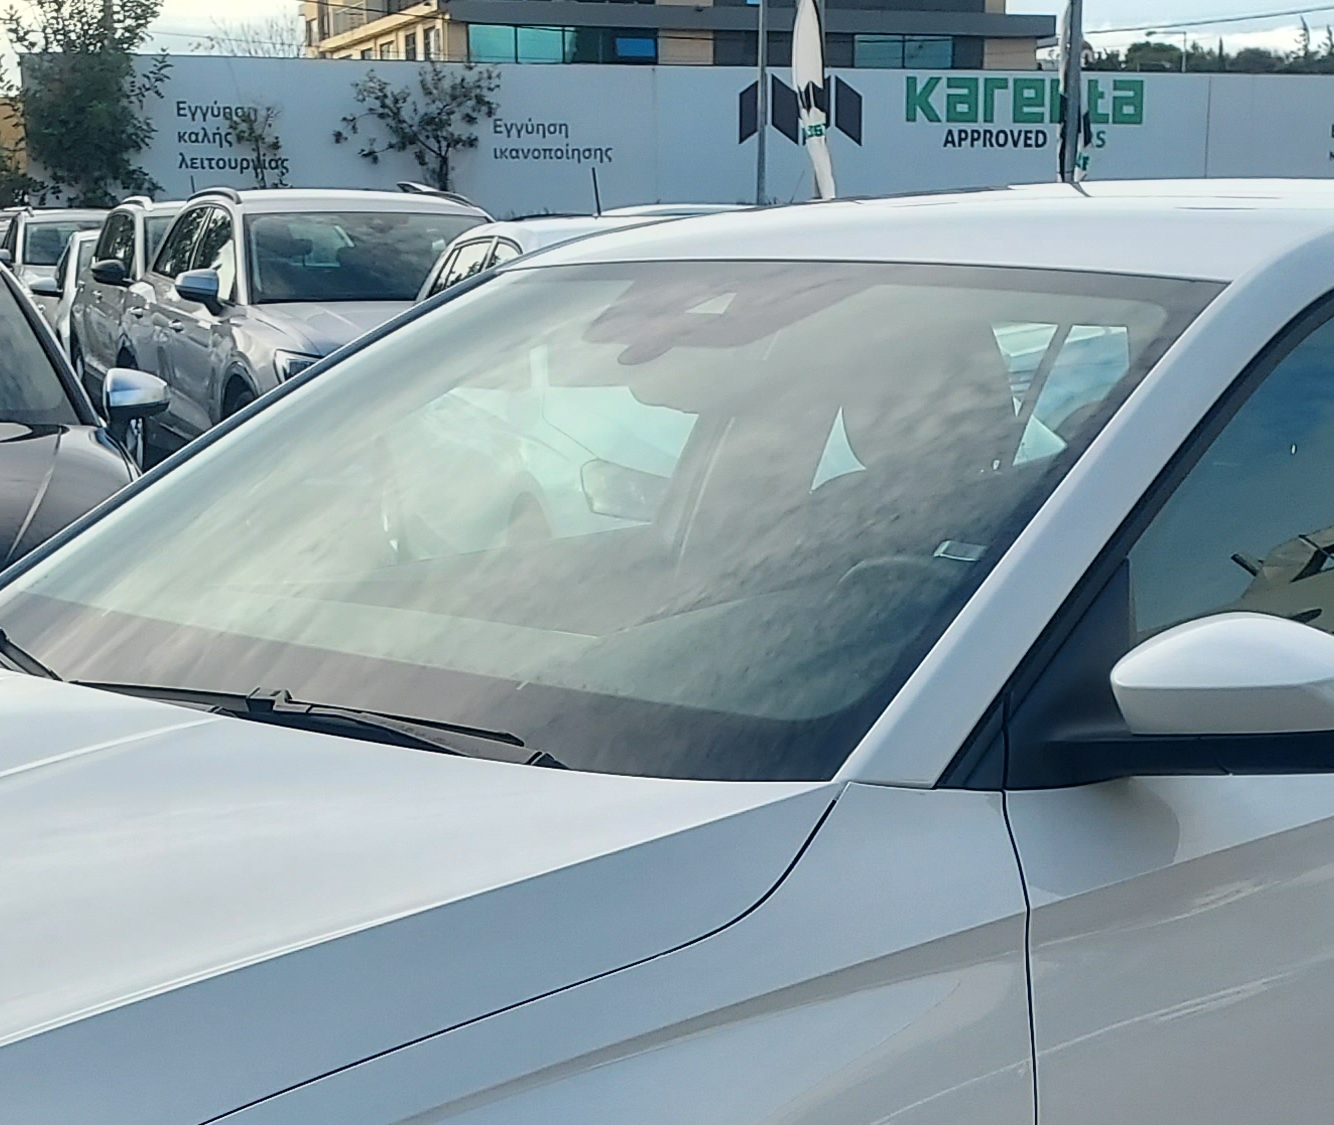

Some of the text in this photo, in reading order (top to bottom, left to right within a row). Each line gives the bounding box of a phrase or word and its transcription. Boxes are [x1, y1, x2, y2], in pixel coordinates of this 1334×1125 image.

[177, 127, 233, 148] καλής
[493, 117, 569, 139] Εγγύηση
[943, 129, 1047, 148] APPROVED
[493, 143, 614, 164] ικανοποίησης
